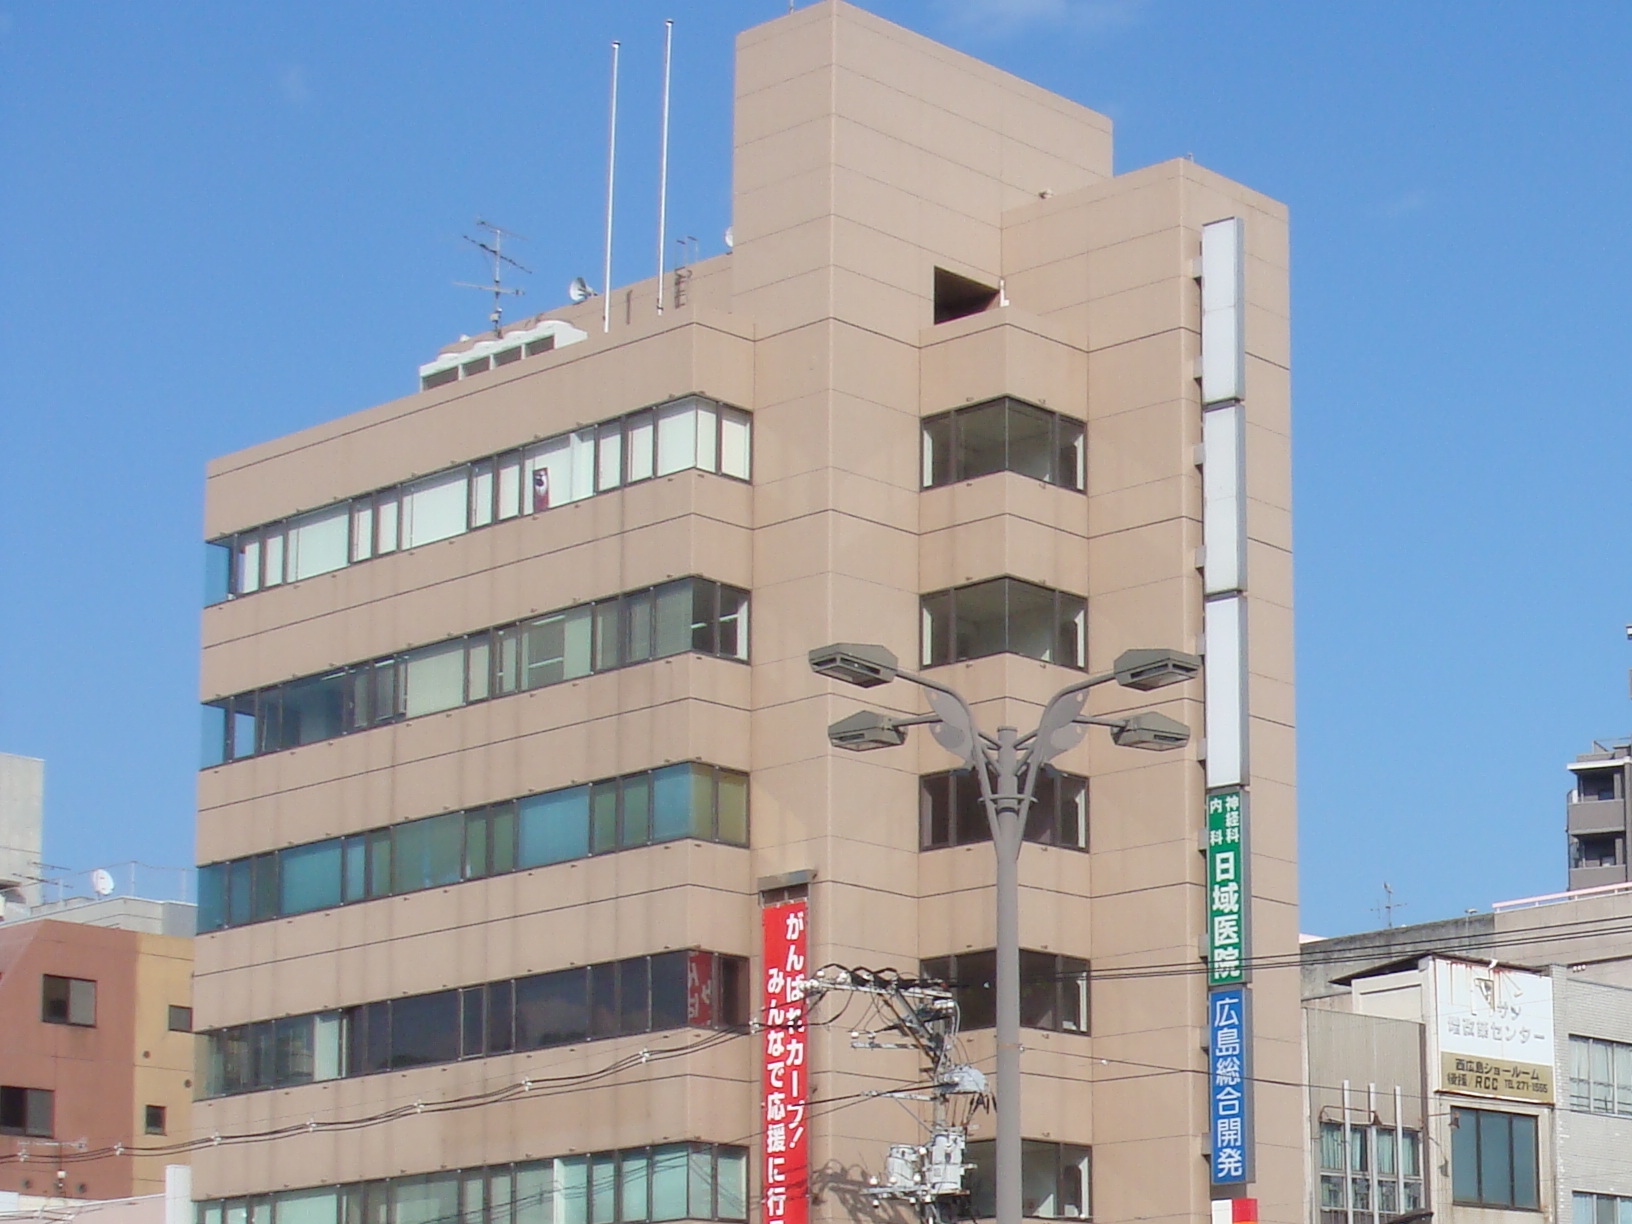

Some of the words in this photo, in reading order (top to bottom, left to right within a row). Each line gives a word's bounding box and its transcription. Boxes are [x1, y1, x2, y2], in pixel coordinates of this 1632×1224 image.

[1209, 798, 1223, 846] 内科
[1225, 795, 1240, 845] 神経科
[1211, 851, 1241, 981] 日域医院
[1213, 996, 1244, 1178] 広島総合開発
[1455, 1057, 1540, 1081] 西広島ショールーム
[1475, 1075, 1499, 1092] RCC
